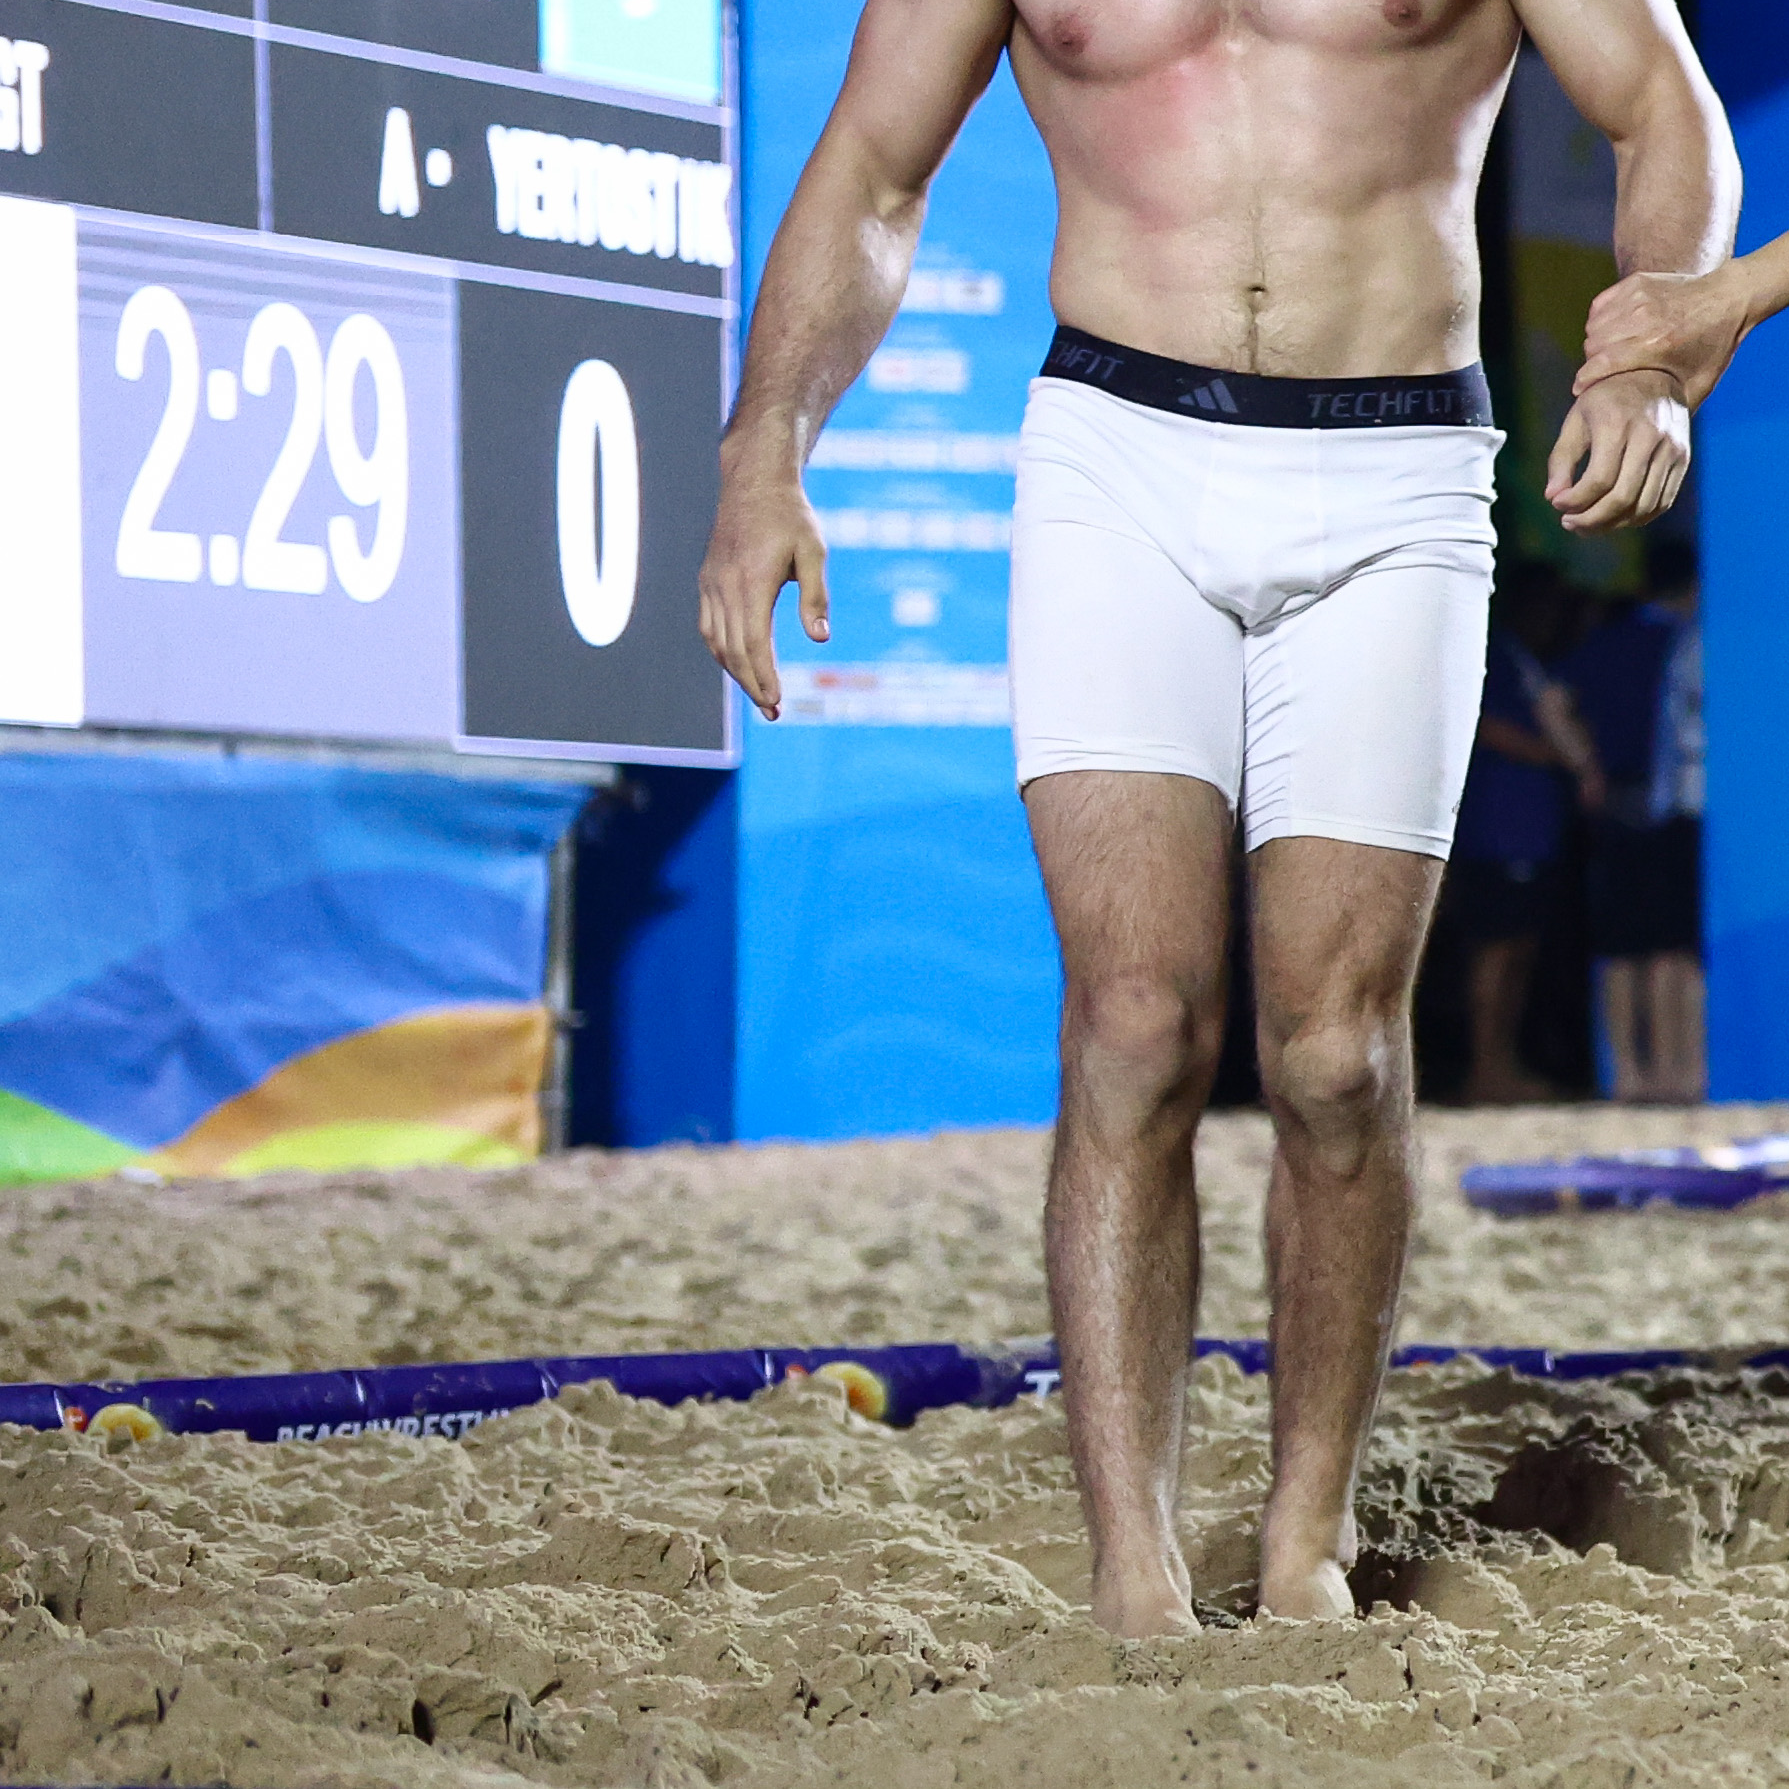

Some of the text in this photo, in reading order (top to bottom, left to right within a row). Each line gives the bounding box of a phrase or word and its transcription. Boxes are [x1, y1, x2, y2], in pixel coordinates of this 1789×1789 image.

[115, 285, 409, 603] 2:29
[557, 359, 640, 647] 0
[1306, 387, 1456, 420] TECHFIT
